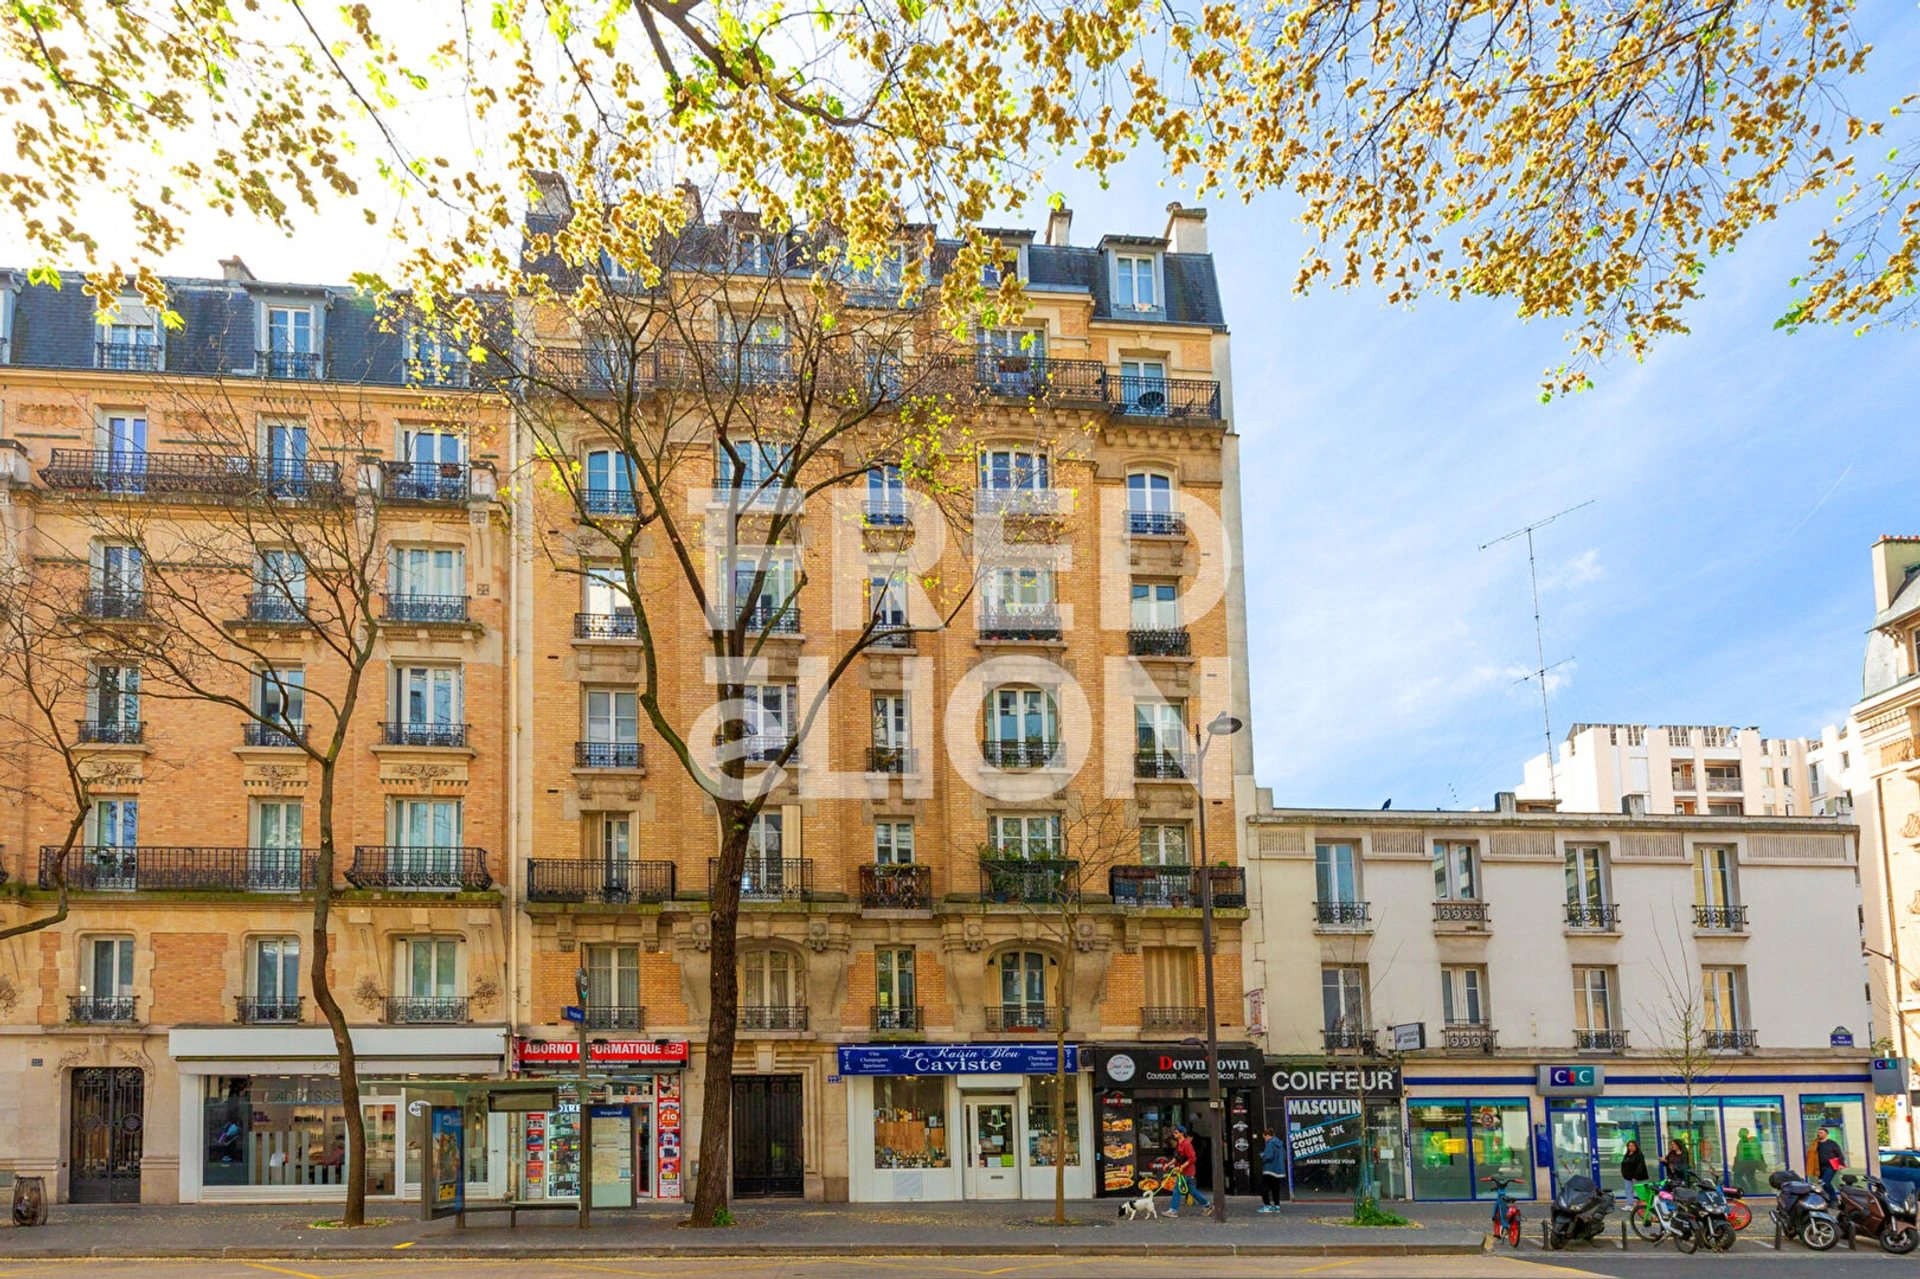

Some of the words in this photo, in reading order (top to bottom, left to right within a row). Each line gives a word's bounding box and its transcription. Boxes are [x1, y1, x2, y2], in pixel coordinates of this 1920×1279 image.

[524, 1043, 573, 1054] ABORNO
[928, 1048, 979, 1060] Raisin
[915, 1057, 1002, 1071] Caviste
[1159, 1056, 1249, 1070] Downown
[1876, 1060, 1895, 1068] CIC
[1272, 1071, 1393, 1090] COIFFEUR
[1554, 1070, 1591, 1083] CIC
[1288, 1100, 1362, 1115] MASCULIN
[661, 1110, 682, 1121] ria
[1289, 1126, 1325, 1141] SHAMP.
[1331, 1125, 1345, 1136] 27€
[1292, 1135, 1325, 1149] COUPE
